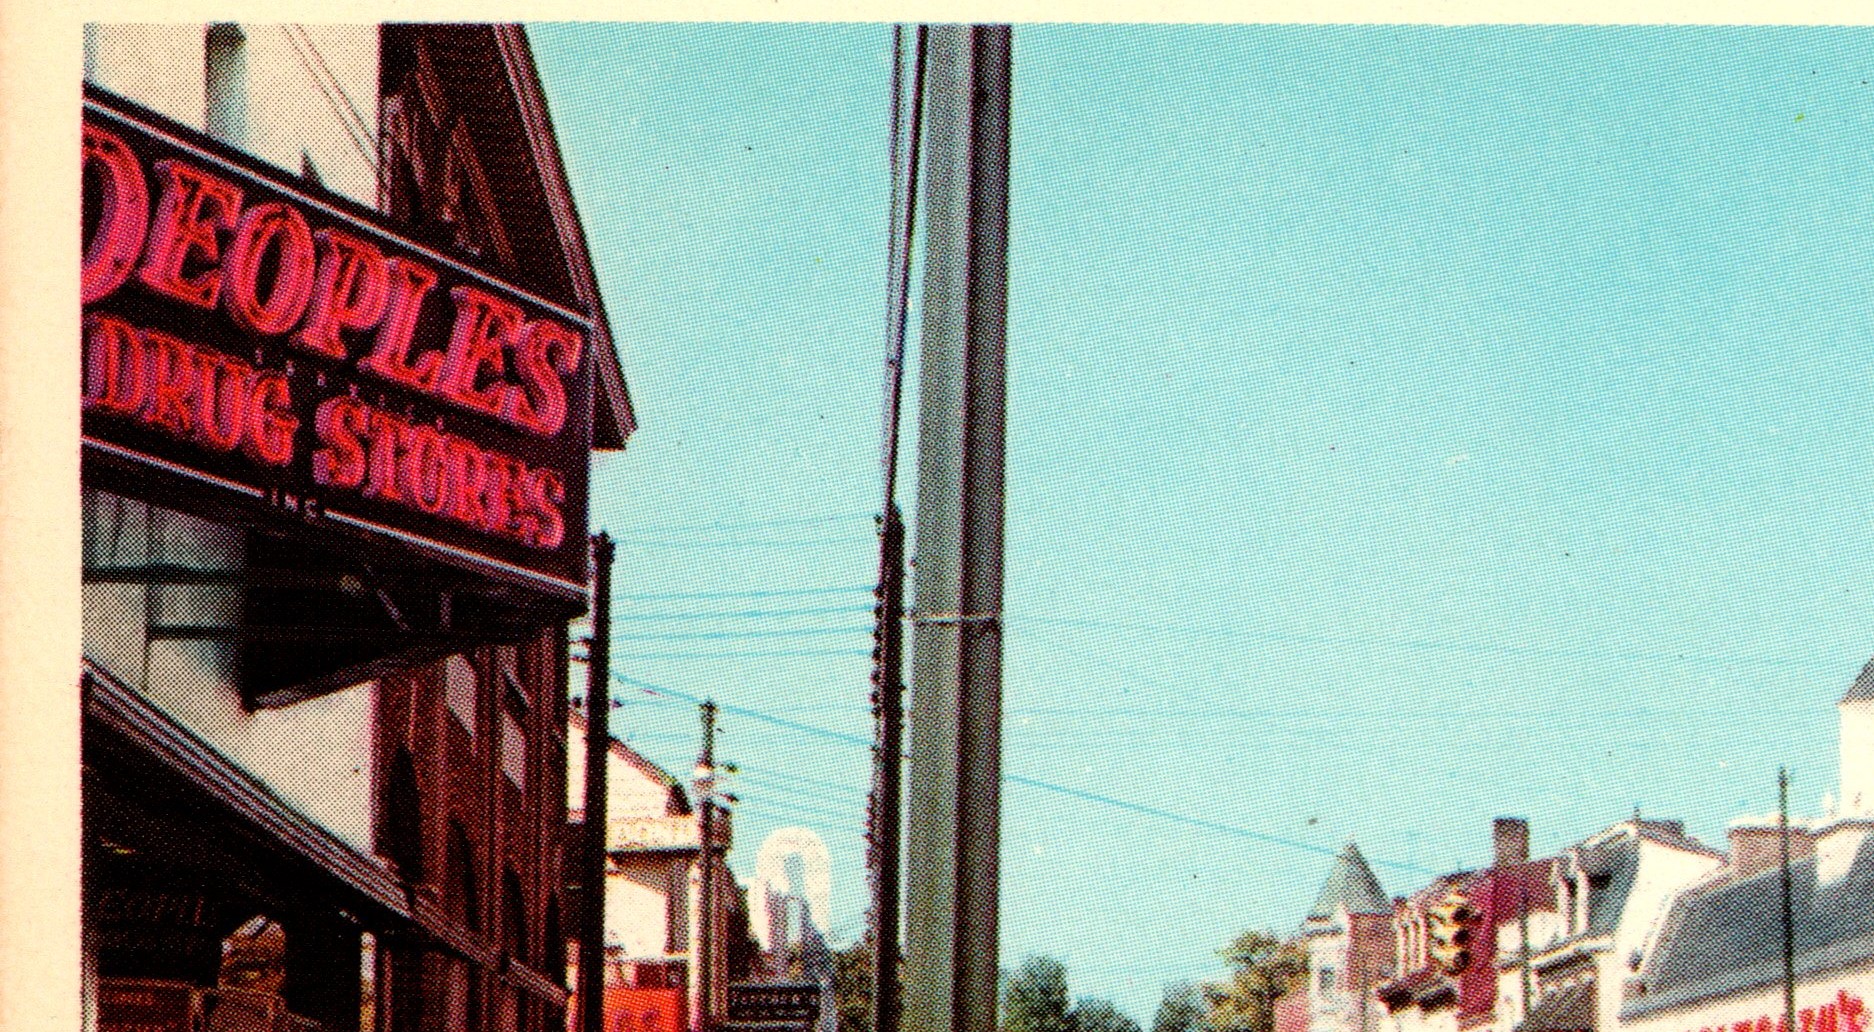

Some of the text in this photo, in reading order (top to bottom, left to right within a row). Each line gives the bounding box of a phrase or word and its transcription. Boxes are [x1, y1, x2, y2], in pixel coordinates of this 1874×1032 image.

[82, 310, 298, 466] DRUG
[313, 394, 565, 550] STORES
[270, 487, 318, 520] INC
